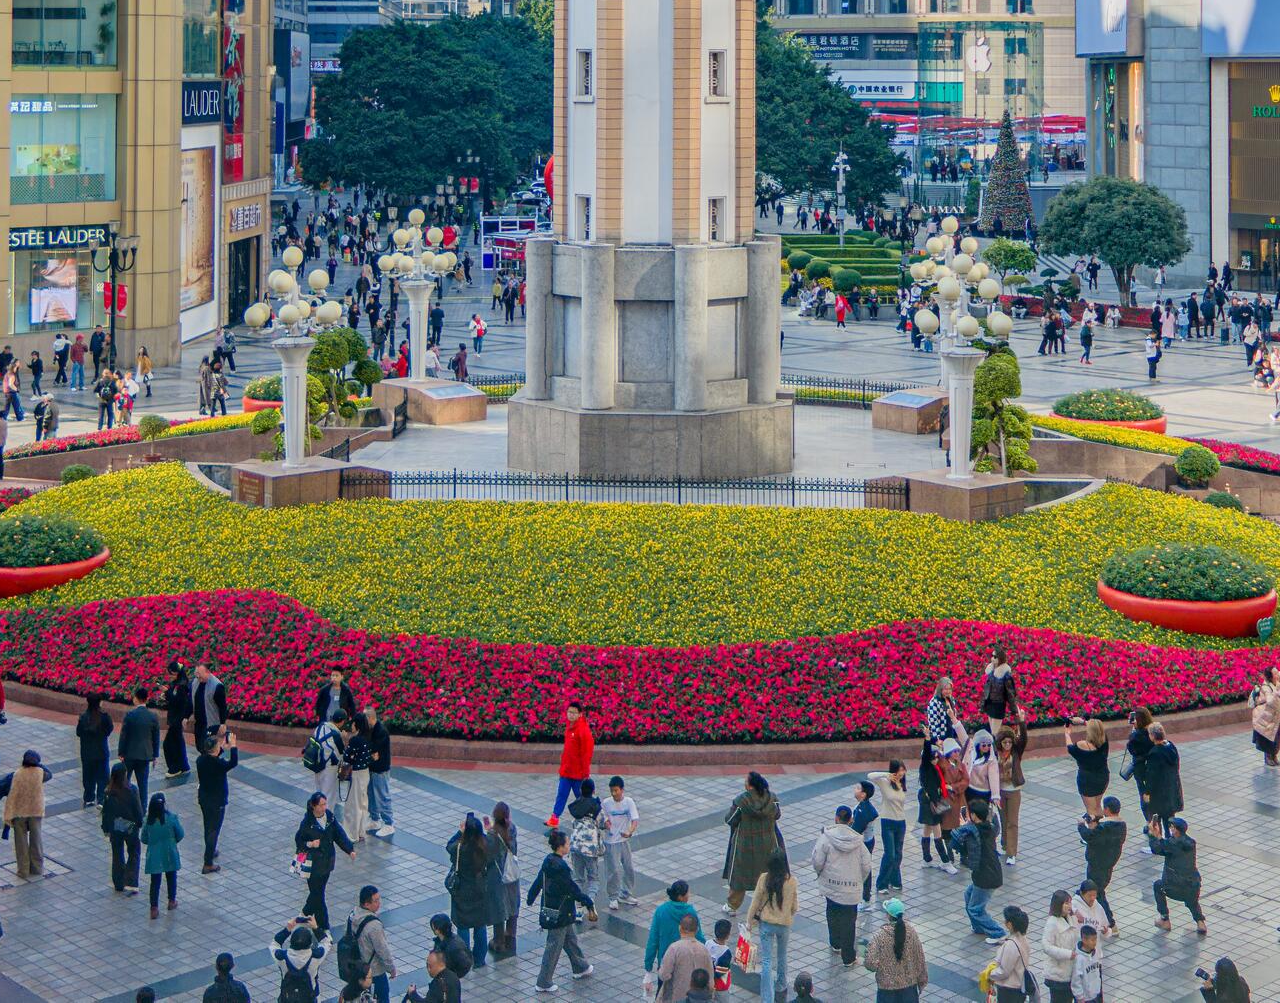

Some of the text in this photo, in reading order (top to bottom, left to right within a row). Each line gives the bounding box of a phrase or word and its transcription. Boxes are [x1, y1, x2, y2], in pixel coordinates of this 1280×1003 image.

[858, 85, 904, 94] 中国农业银行
[184, 90, 220, 117] LAUDER
[48, 228, 106, 245] LAUDER
